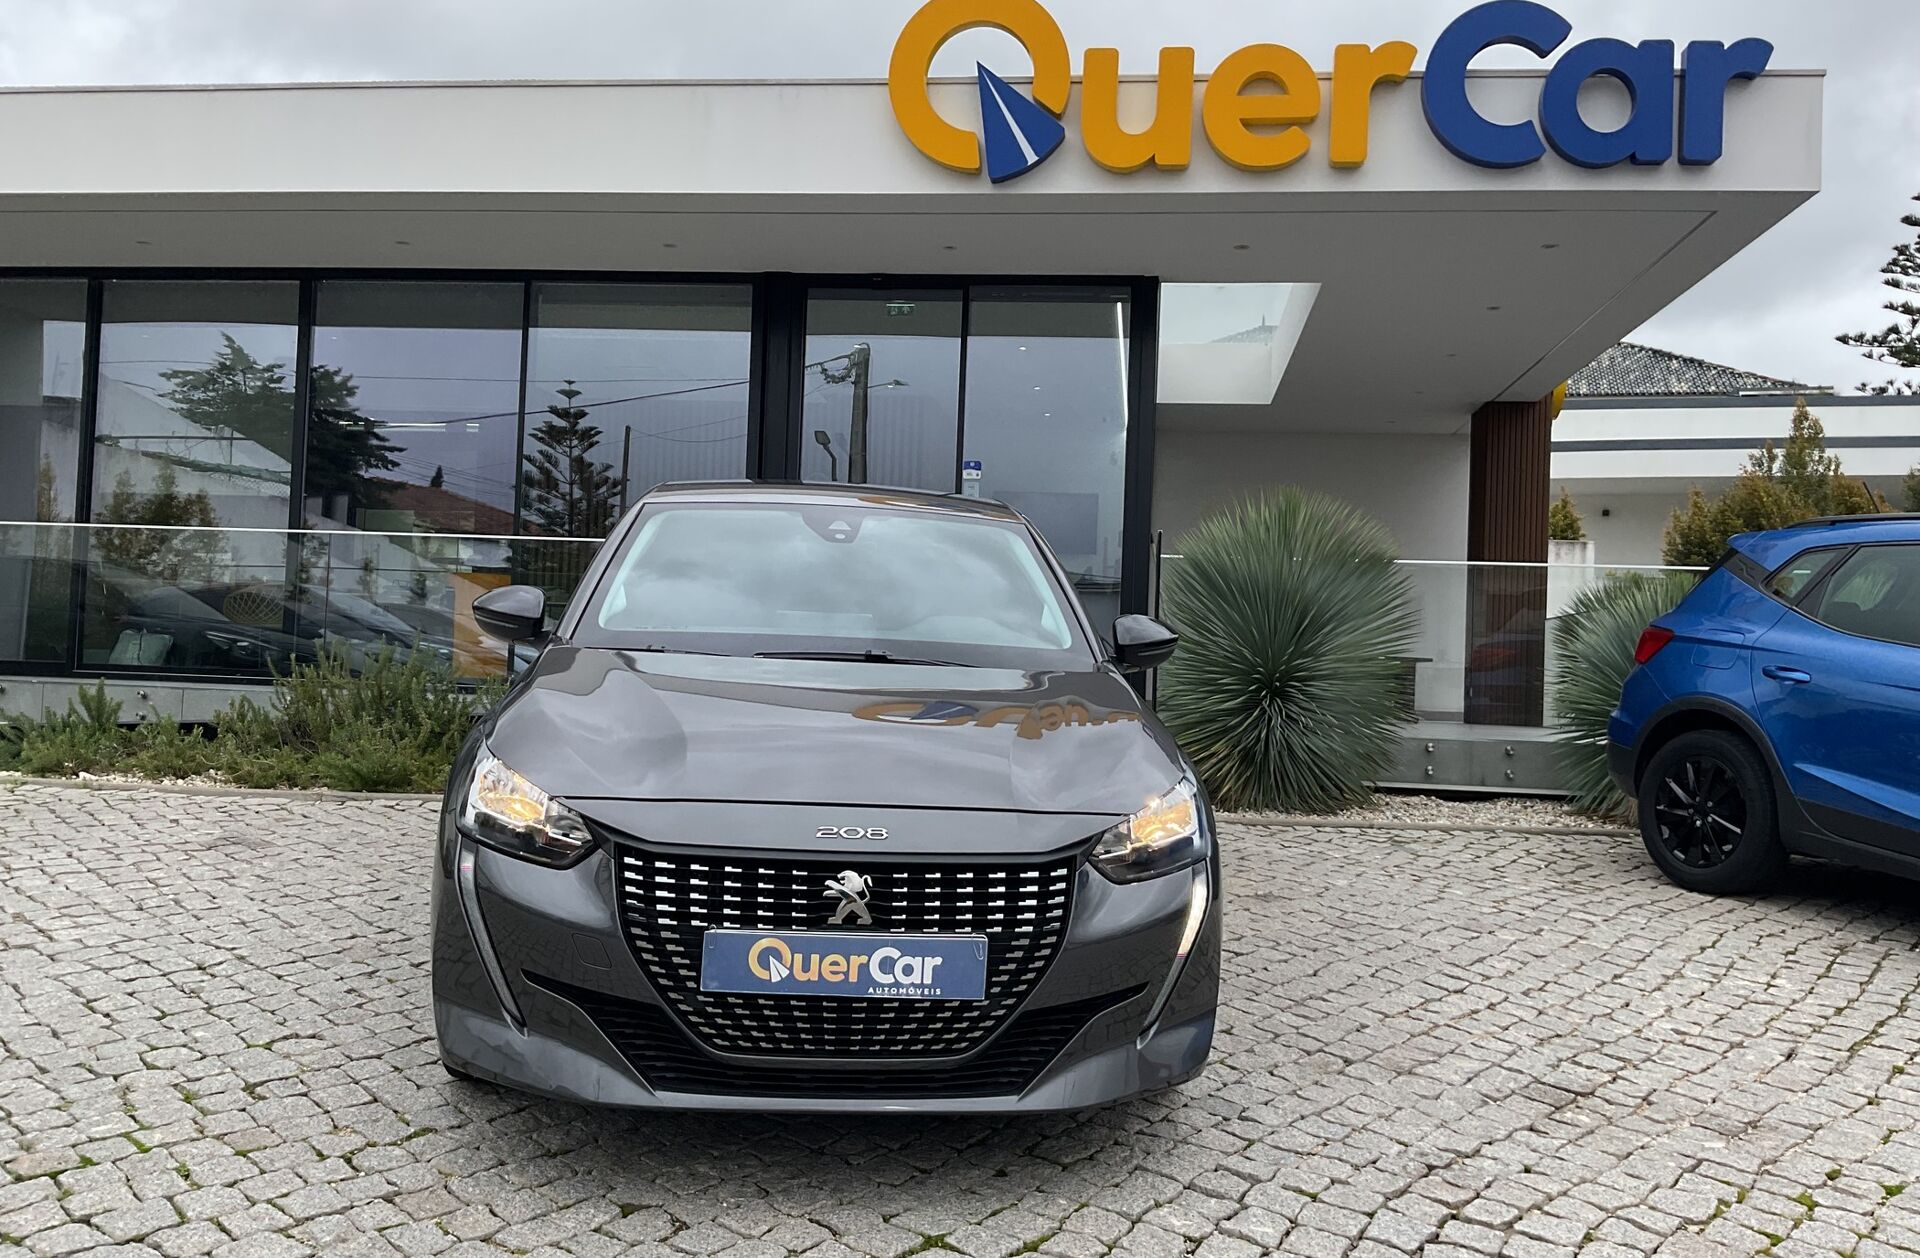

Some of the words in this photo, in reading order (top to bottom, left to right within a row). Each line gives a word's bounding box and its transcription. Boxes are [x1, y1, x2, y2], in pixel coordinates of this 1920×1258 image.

[888, 0, 1774, 184] QuerCar
[815, 825, 889, 840] 208
[748, 937, 943, 984] QuerCar
[867, 986, 942, 996] AUTOMÓVEIS
